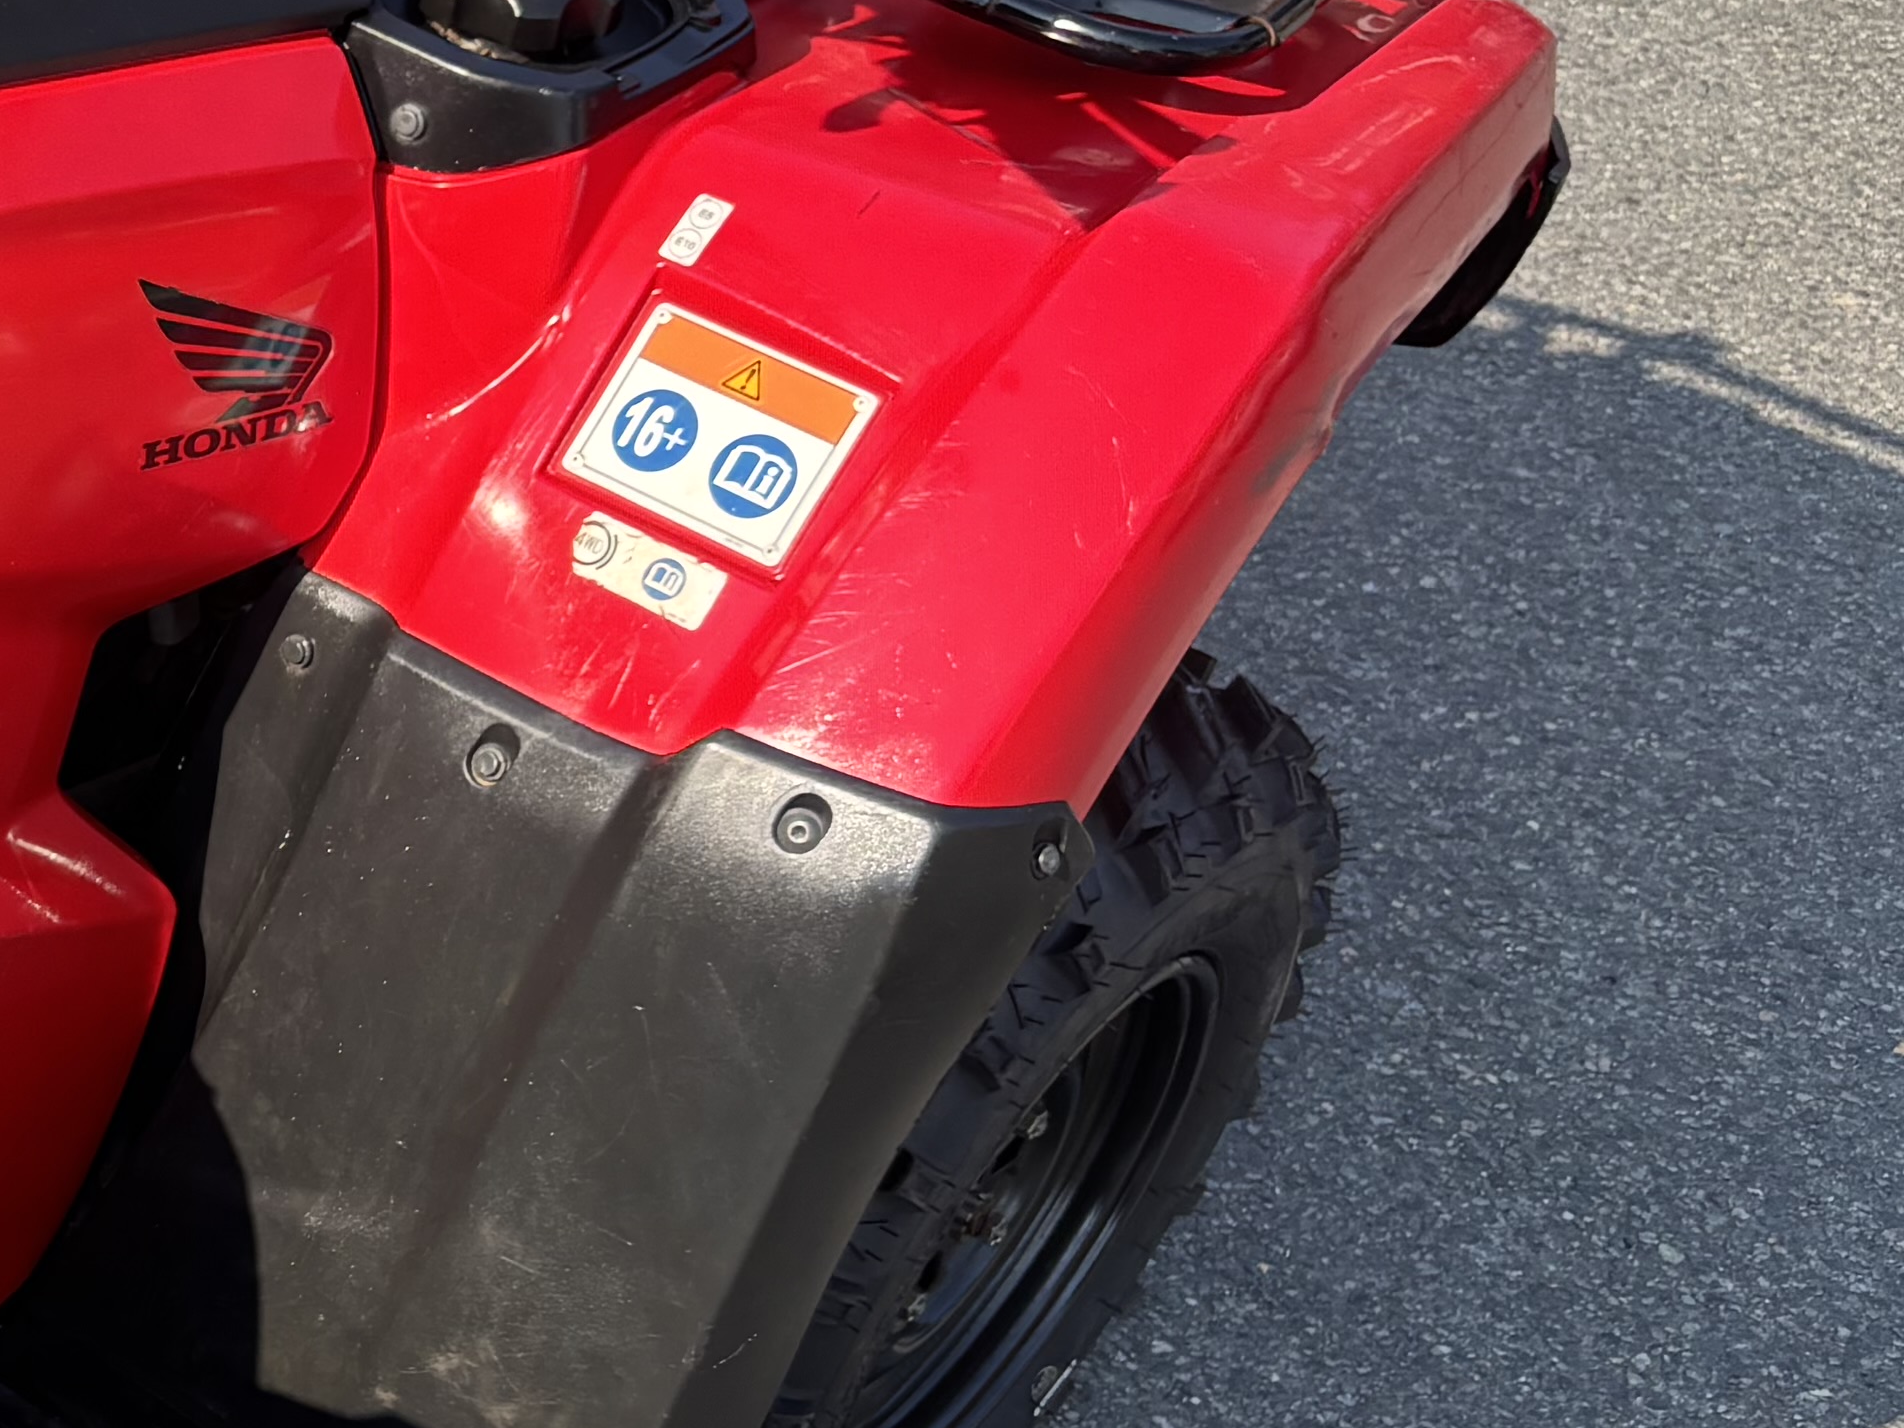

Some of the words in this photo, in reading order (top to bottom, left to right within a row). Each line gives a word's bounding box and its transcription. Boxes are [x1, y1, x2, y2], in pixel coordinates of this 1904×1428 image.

[674, 236, 697, 251] E10
[140, 400, 334, 471] HONDA
[616, 396, 690, 458] 16+
[574, 532, 604, 555] 4WD
